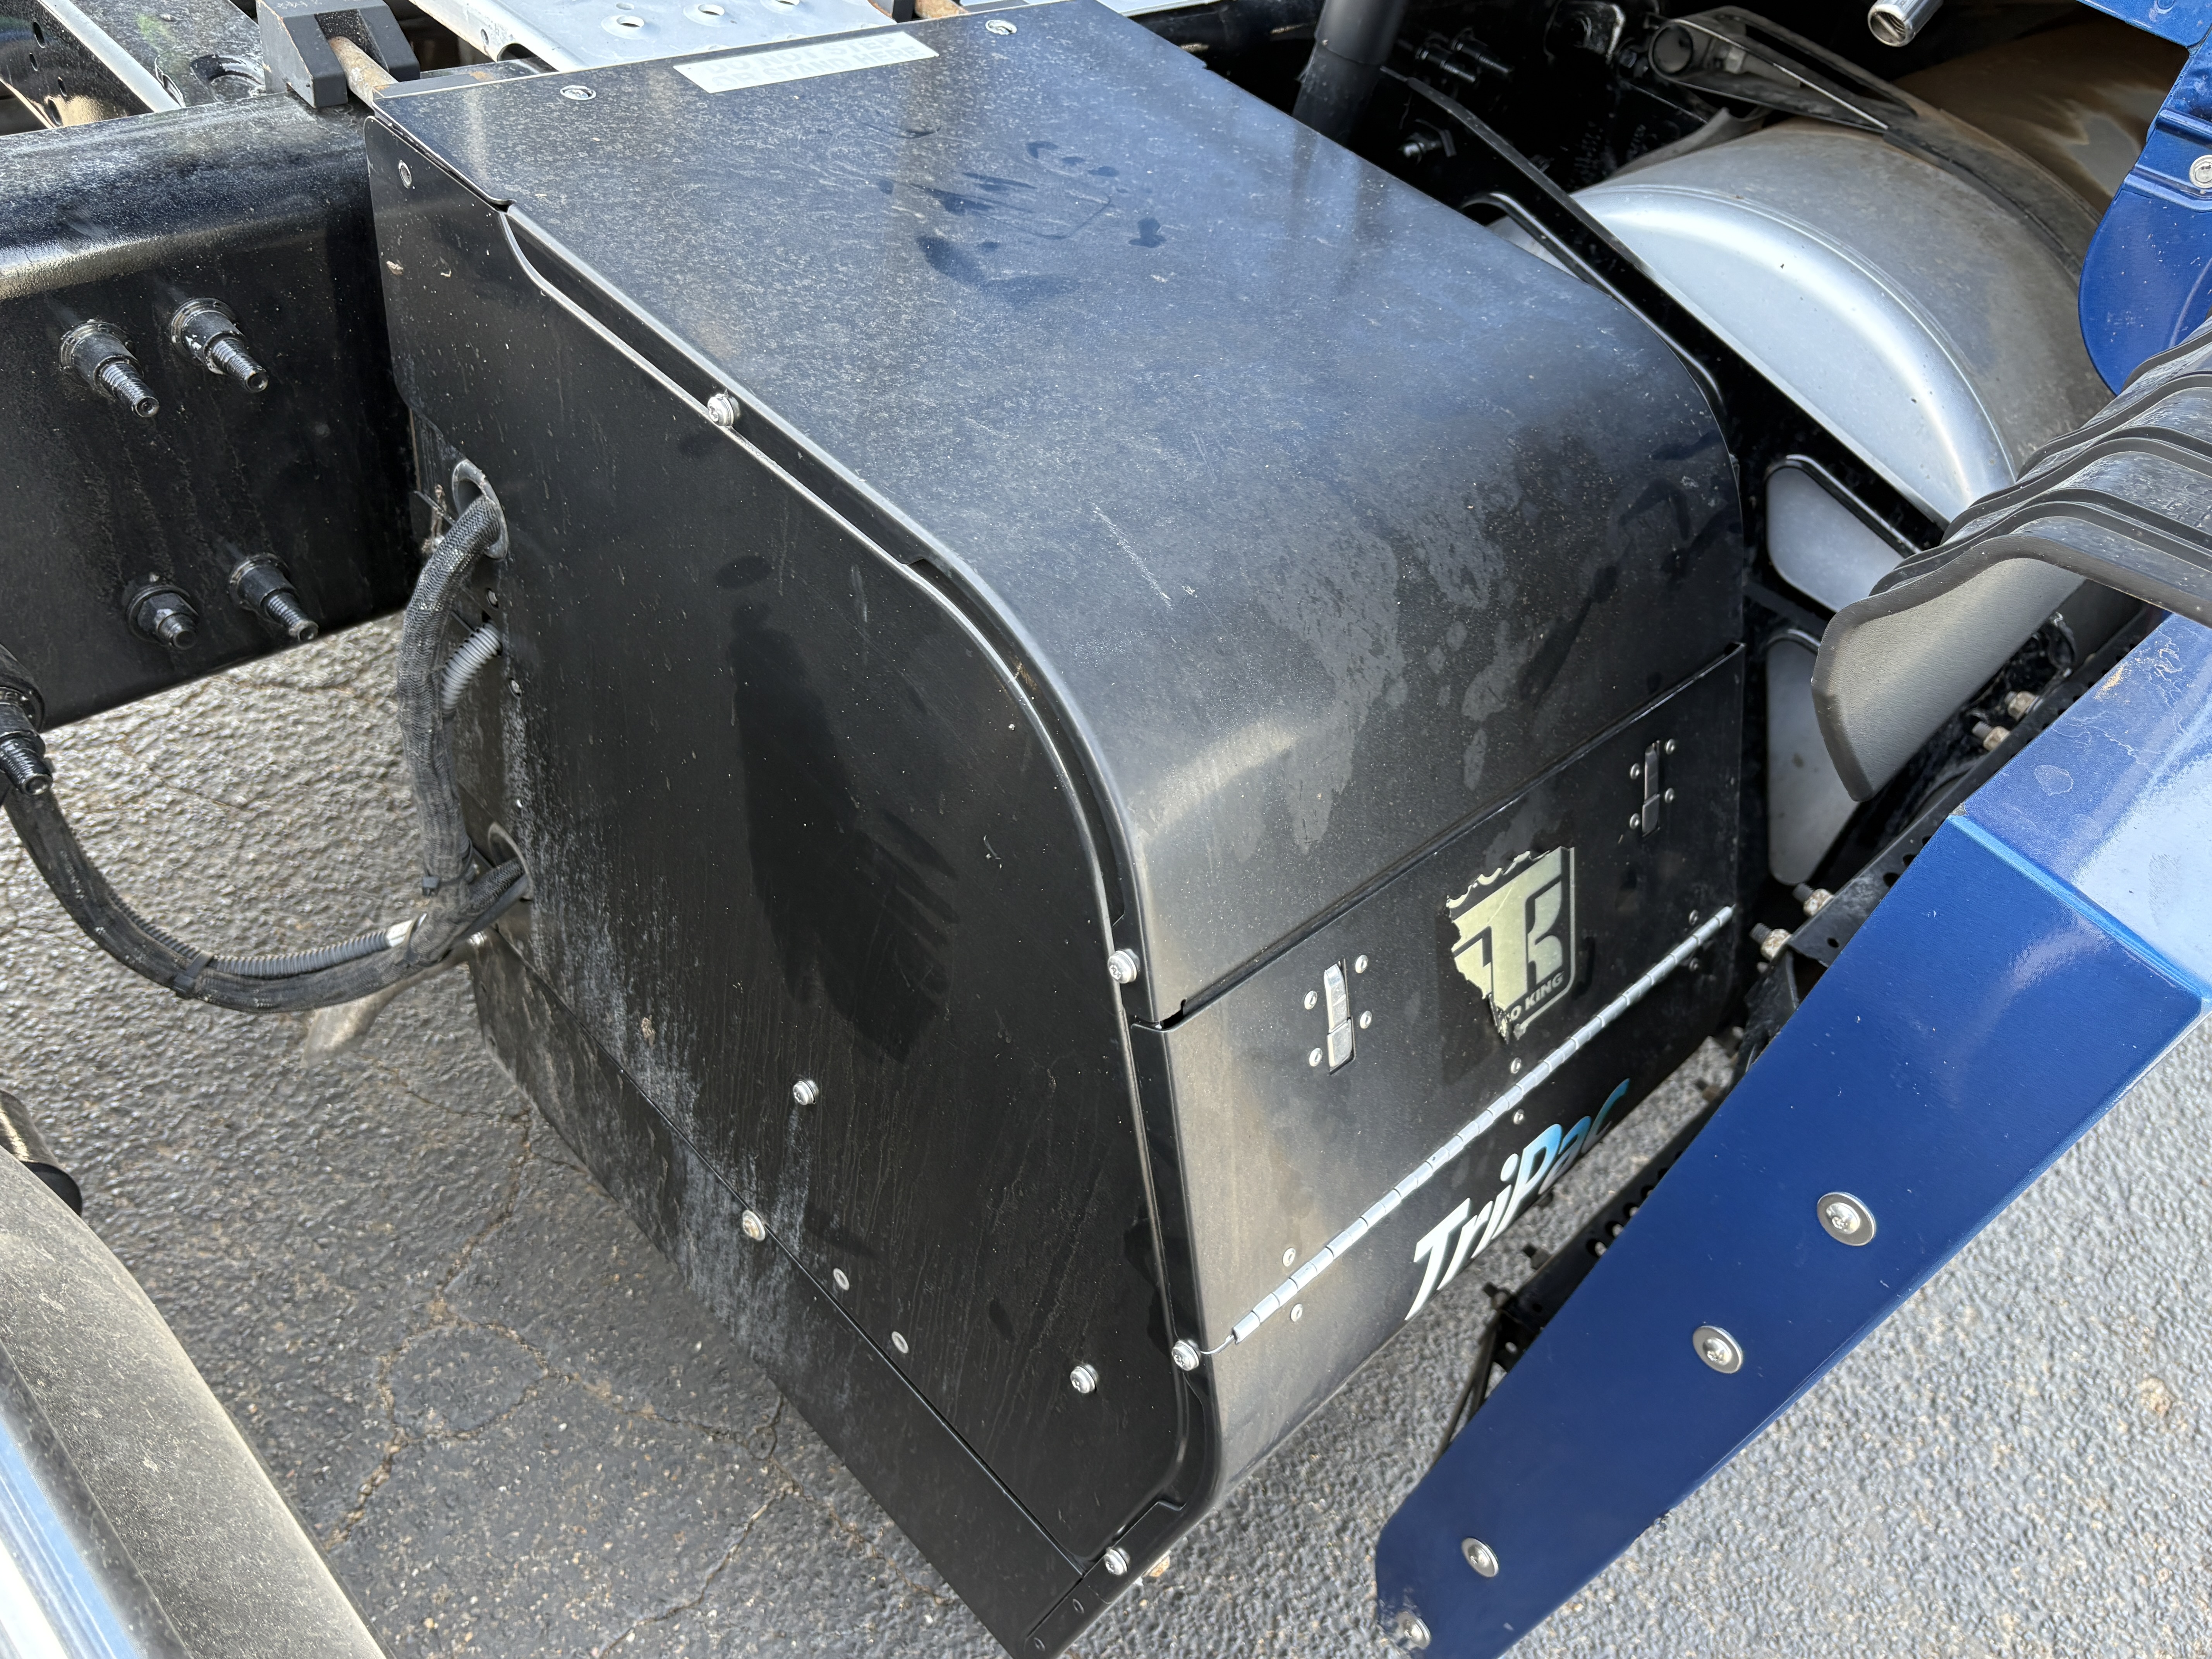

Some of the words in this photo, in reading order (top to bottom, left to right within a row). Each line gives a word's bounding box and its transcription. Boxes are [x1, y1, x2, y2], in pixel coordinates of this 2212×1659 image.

[706, 59, 751, 74] DO
[754, 48, 819, 66] NOT
[823, 38, 895, 55] STEP
[712, 72, 762, 87] OR
[763, 58, 852, 78] STAND
[852, 46, 925, 65] HERE
[1525, 971, 1564, 1011] KING
